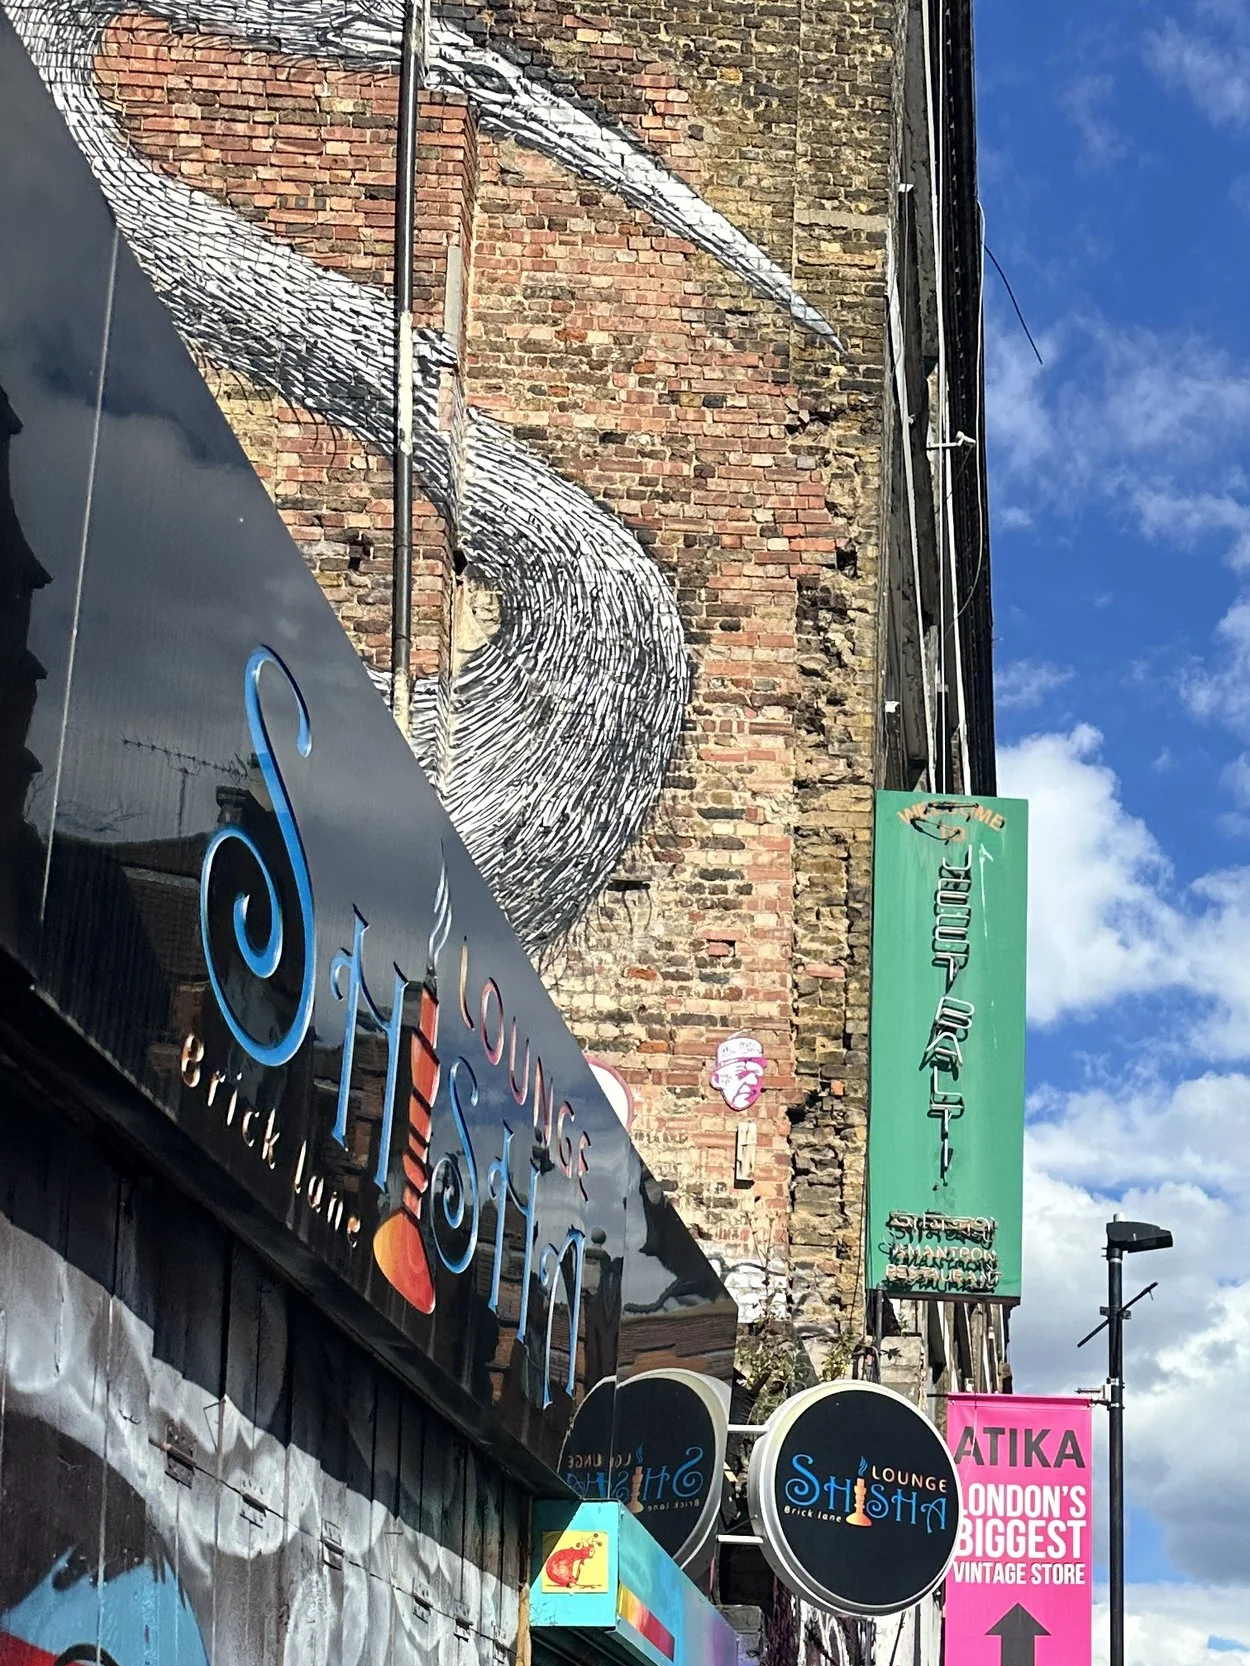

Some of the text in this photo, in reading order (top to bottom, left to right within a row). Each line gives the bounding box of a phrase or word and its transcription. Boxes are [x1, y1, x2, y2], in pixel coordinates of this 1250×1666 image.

[954, 1426, 1086, 1469] ATIKA
[872, 1465, 948, 1494] LOUNGE
[962, 1482, 1087, 1519] ONDON'S
[954, 1518, 1087, 1559] BIGGEST
[953, 1561, 1086, 1586] VINTAGE STORE
